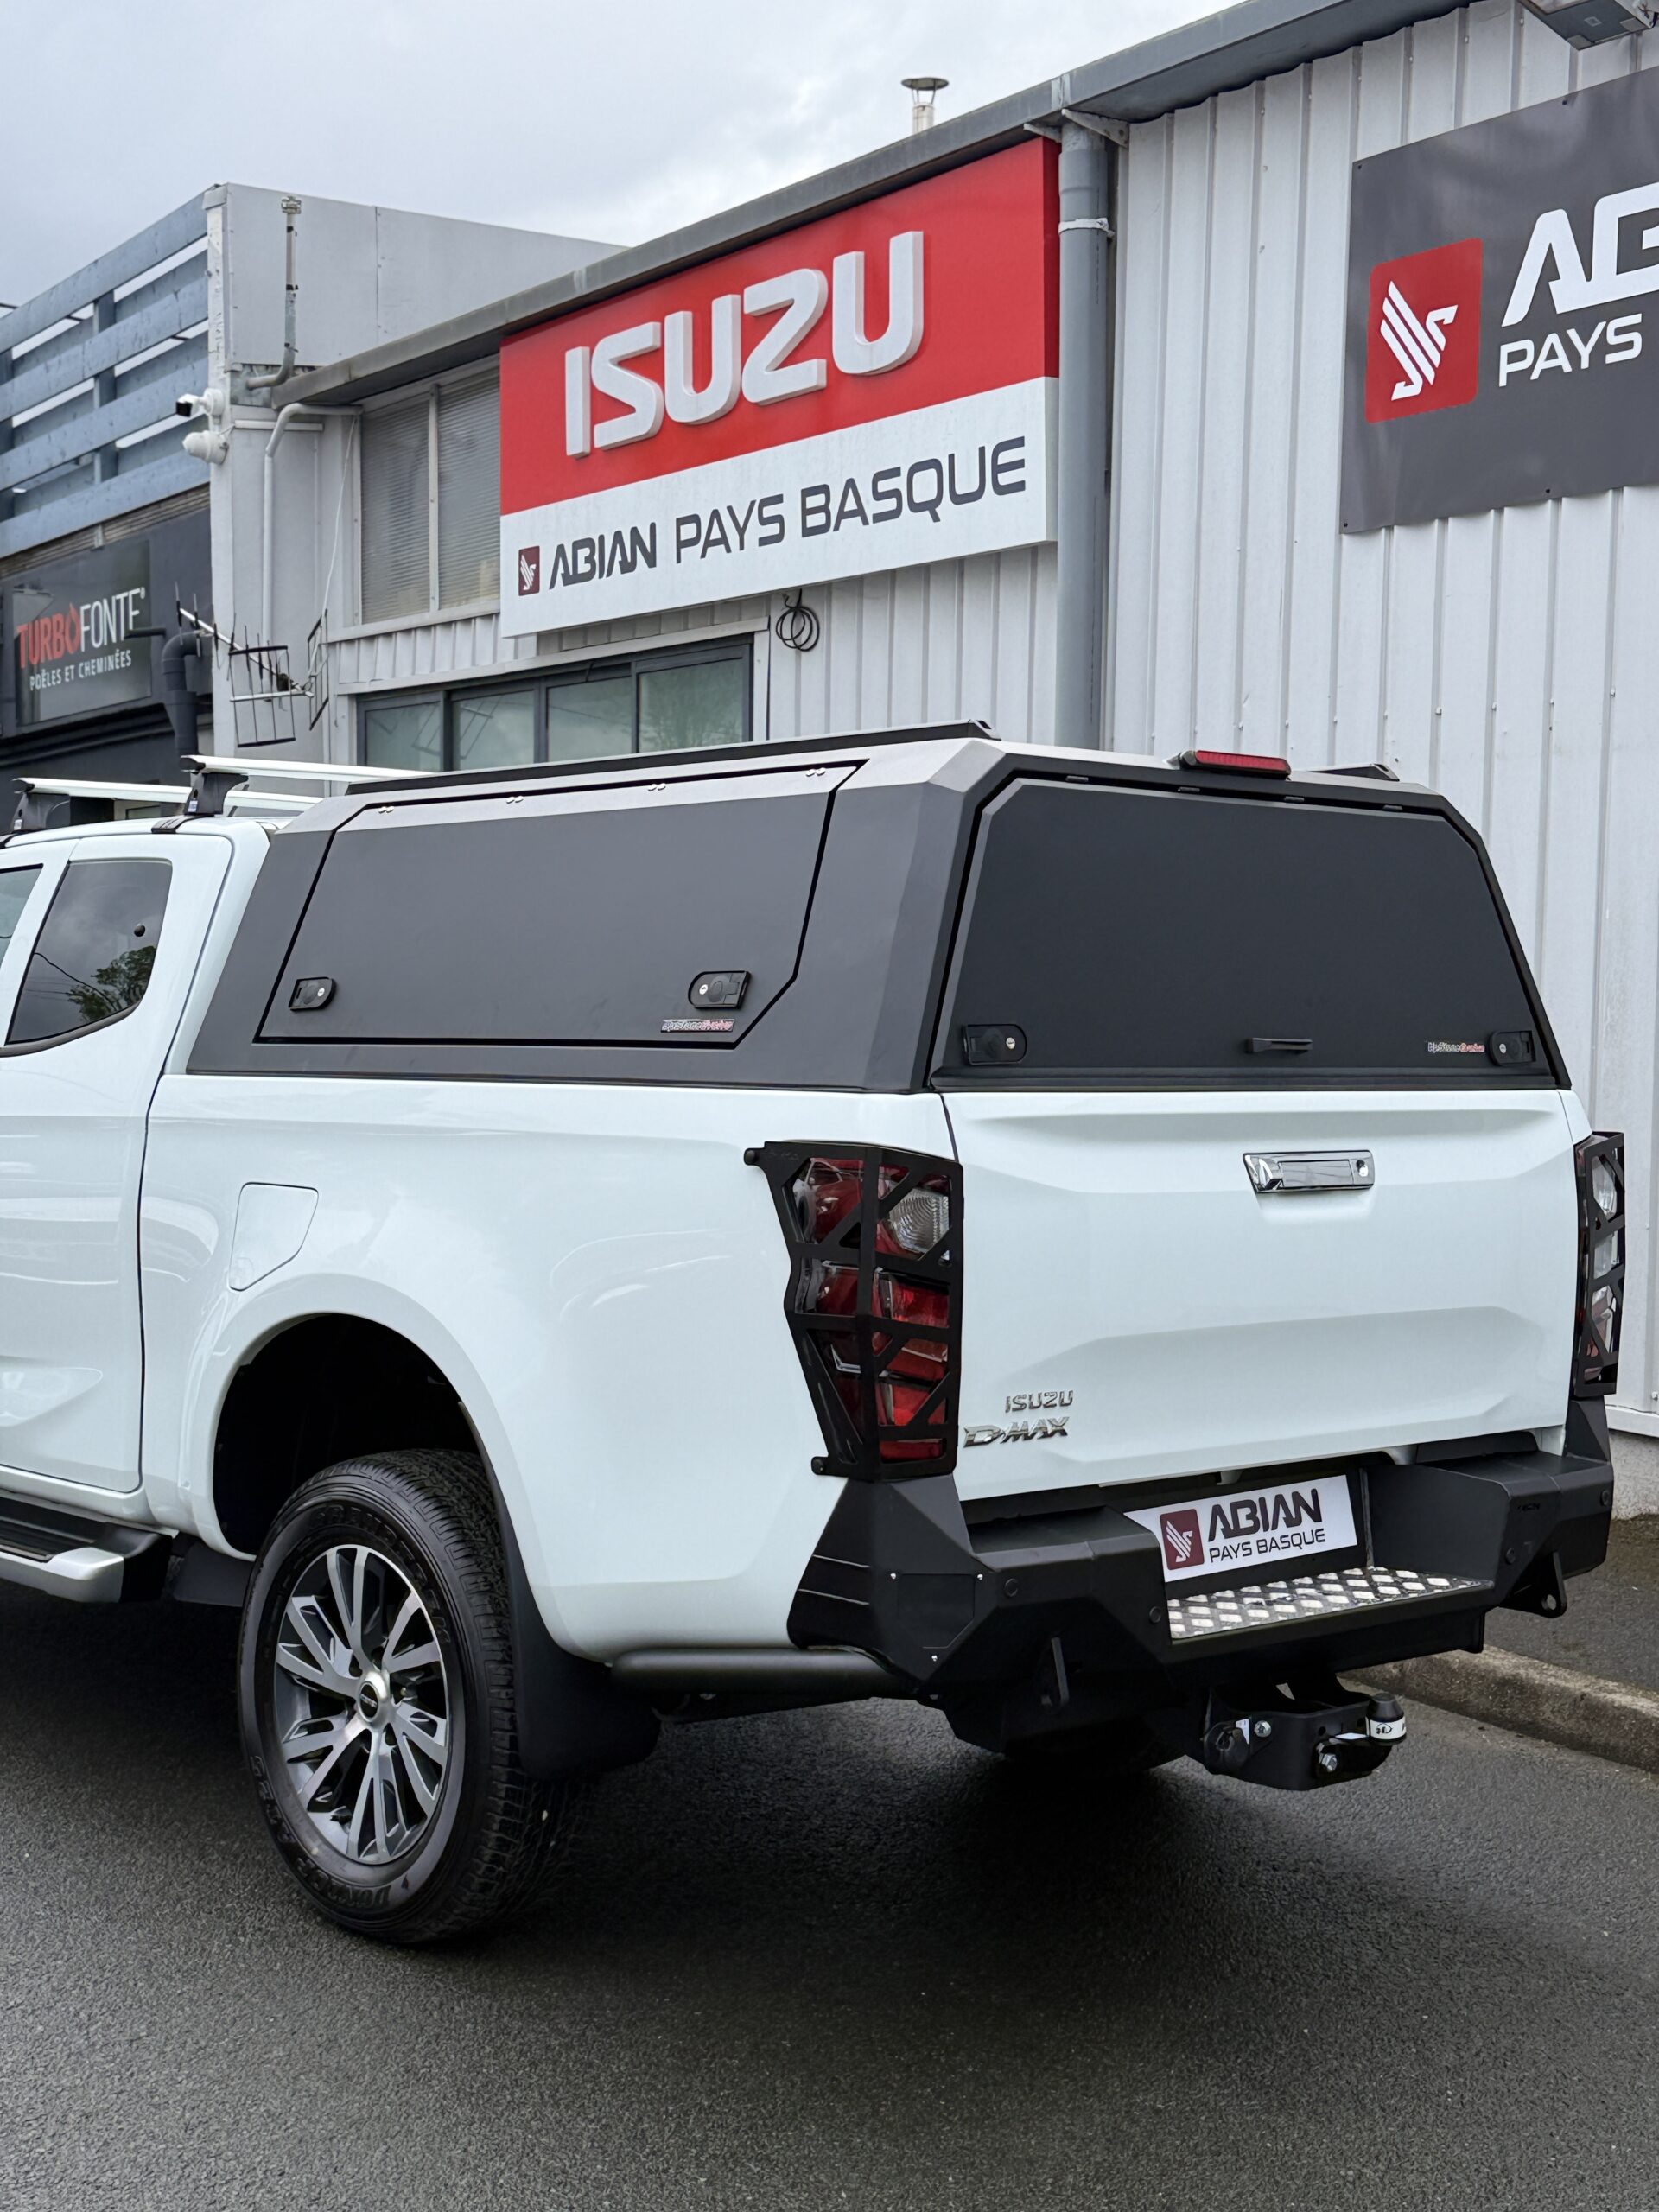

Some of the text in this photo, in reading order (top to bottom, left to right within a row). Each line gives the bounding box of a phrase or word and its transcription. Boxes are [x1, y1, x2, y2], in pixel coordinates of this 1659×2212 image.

[564, 230, 925, 459] ISUZU
[1498, 312, 1643, 388] PAYS
[548, 435, 1027, 590] ABIAN PAYS BASQUE
[64, 664, 75, 683] ET
[78, 648, 132, 678] CHEMINÉES
[1005, 1389, 1074, 1414] ISUZU
[1207, 1488, 1323, 1543] ABIAN
[1209, 1528, 1326, 1563] PAYS BASQUE
